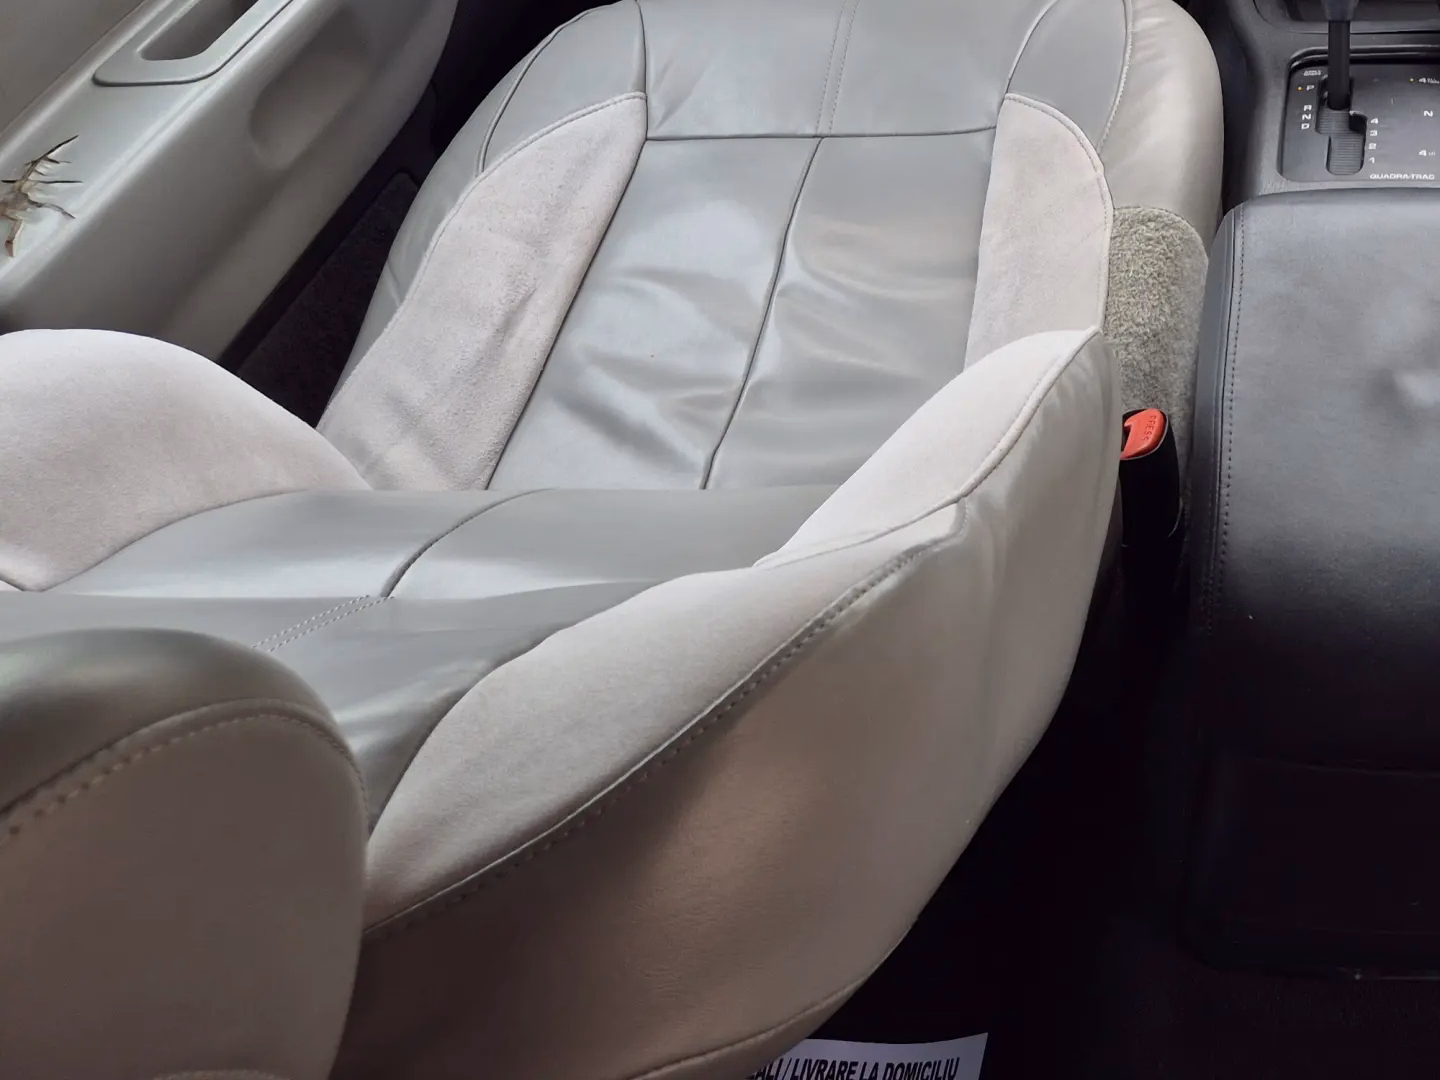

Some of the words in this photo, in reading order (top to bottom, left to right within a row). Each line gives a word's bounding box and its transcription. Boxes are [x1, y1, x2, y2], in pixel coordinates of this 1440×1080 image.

[1303, 104, 1312, 112] R
[1418, 149, 1427, 157] 4
[1143, 415, 1157, 441] PRESS
[789, 1058, 859, 1080] LIVRARE
[859, 1062, 879, 1080] LA
[882, 1057, 960, 1080] DOMICILIU
